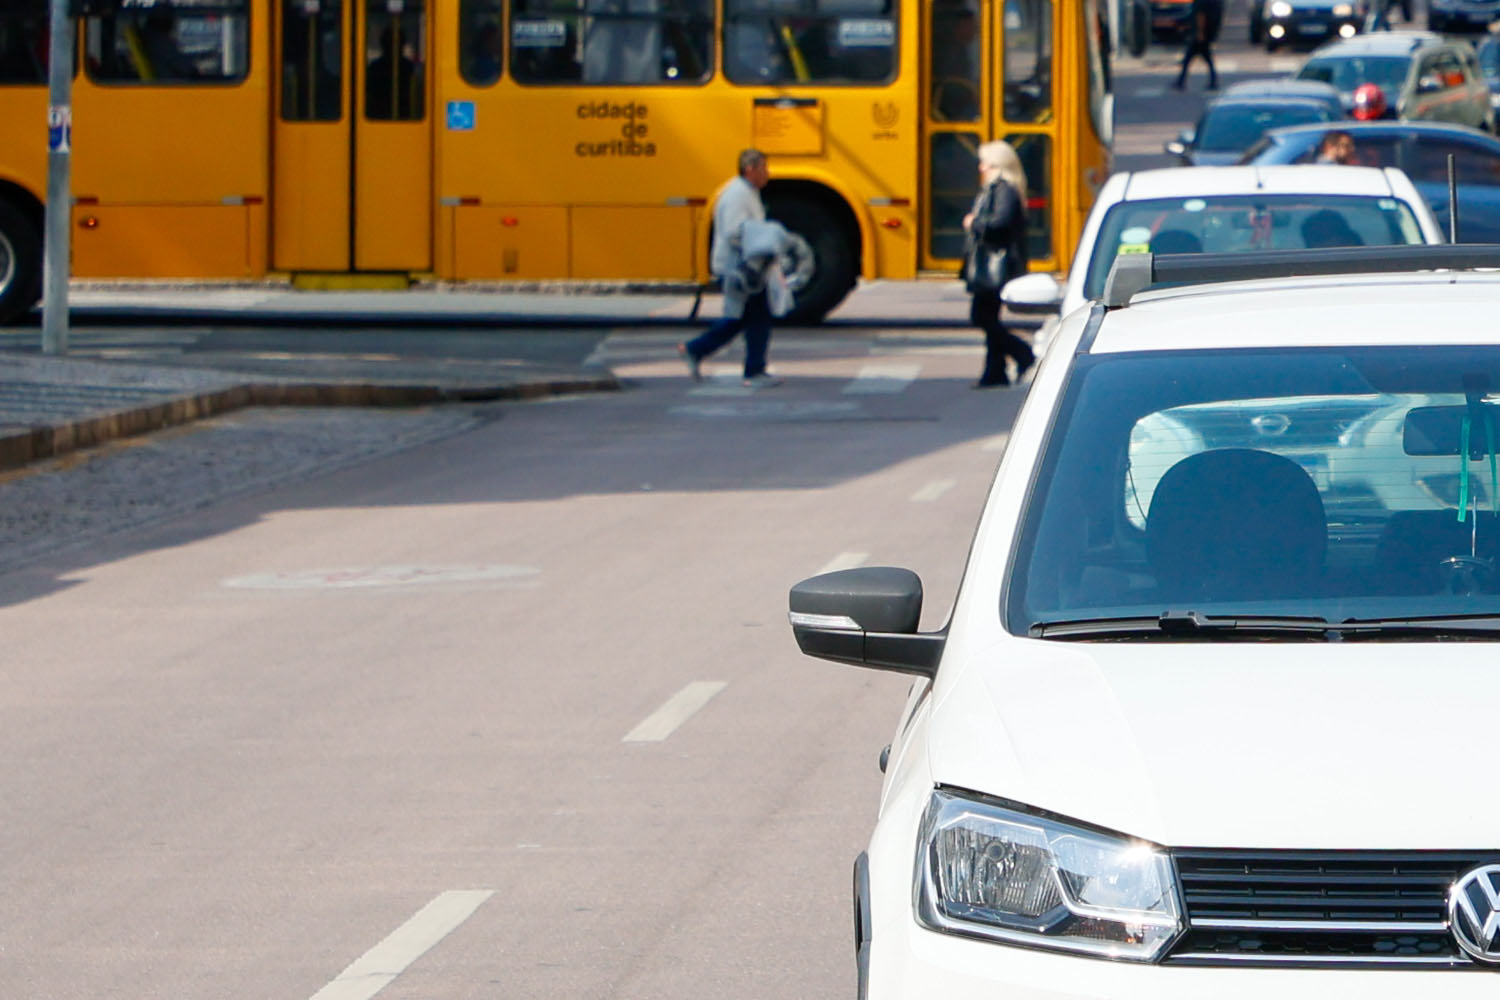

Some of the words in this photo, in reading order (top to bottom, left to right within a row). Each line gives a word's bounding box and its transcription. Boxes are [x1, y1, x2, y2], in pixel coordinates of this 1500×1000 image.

[576, 101, 648, 119] cidade
[622, 119, 648, 138] de
[575, 138, 657, 157] curitiba
